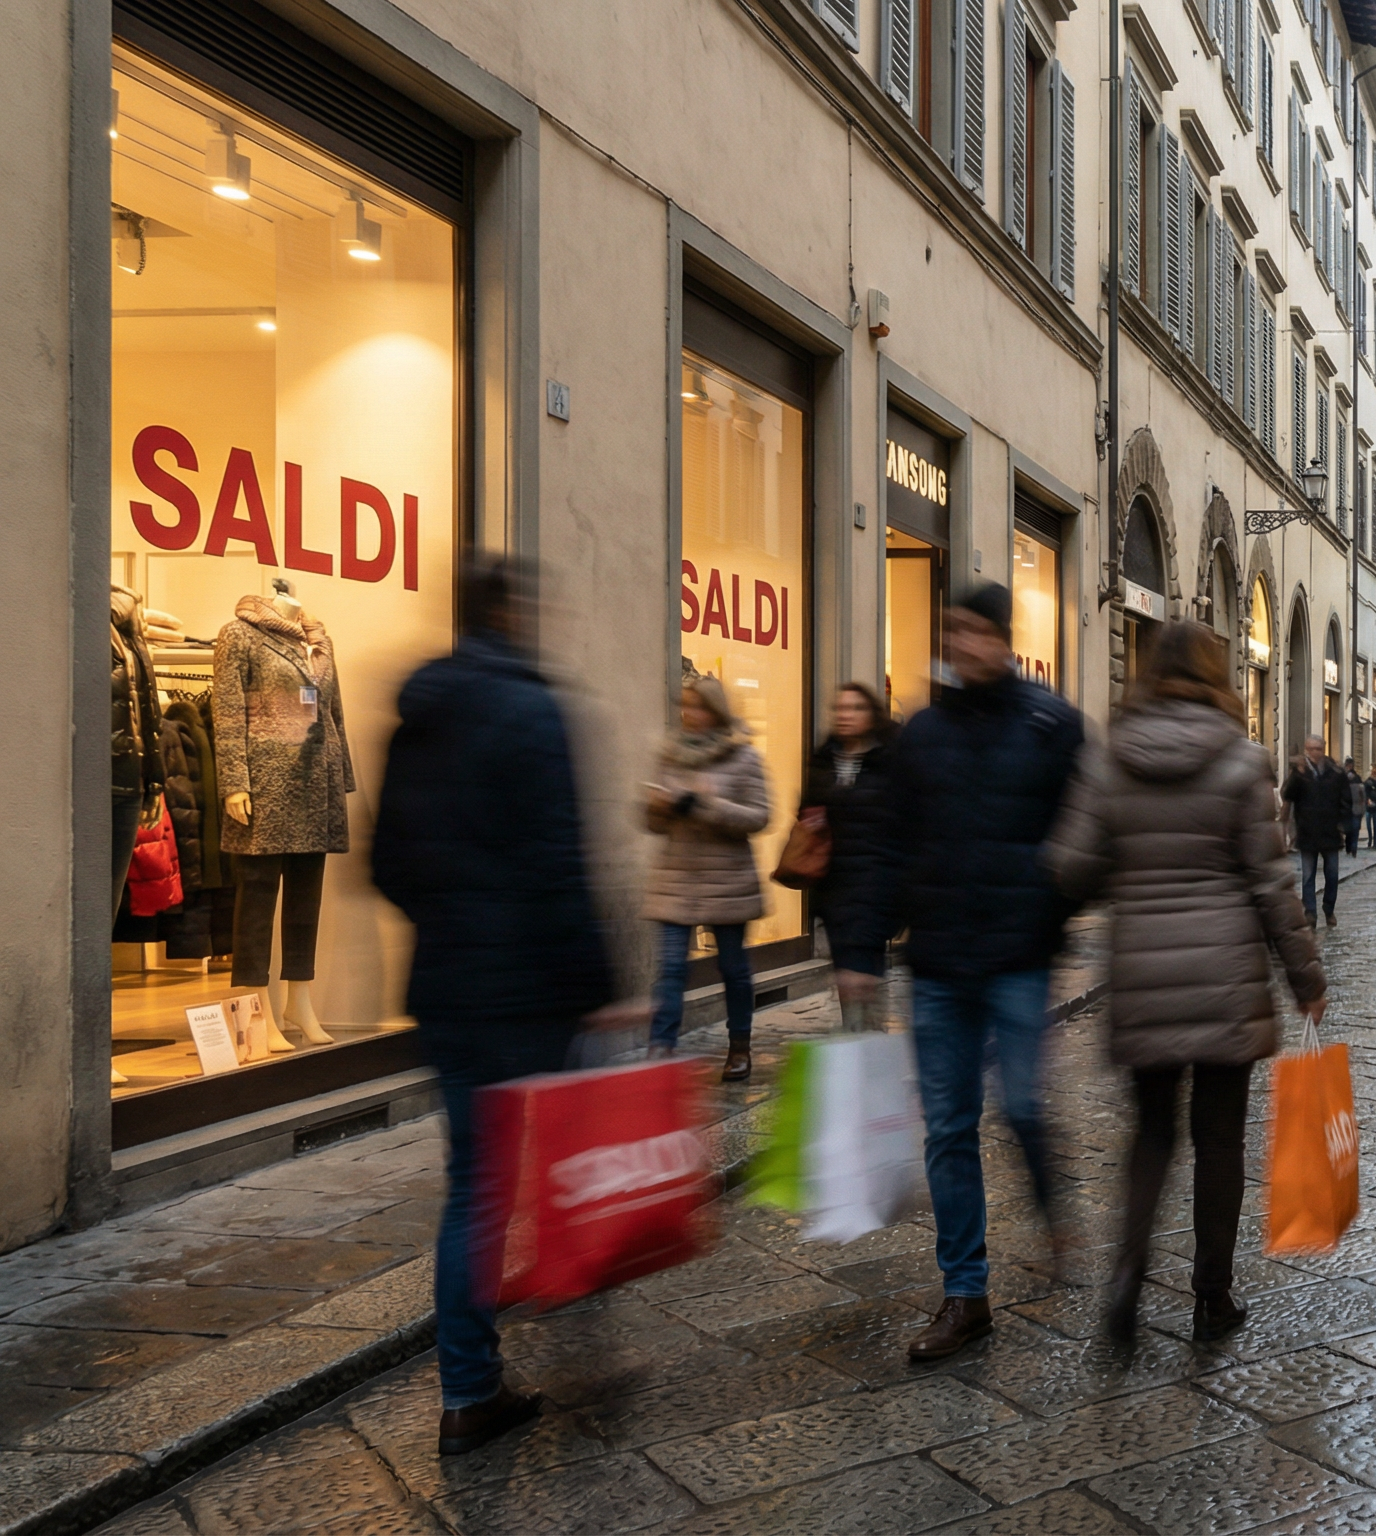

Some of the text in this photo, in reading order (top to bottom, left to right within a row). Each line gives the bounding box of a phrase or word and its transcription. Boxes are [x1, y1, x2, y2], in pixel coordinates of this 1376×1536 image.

[131, 426, 419, 591] SALDI
[886, 439, 947, 506] ANSONG
[681, 560, 788, 650] SALDI
